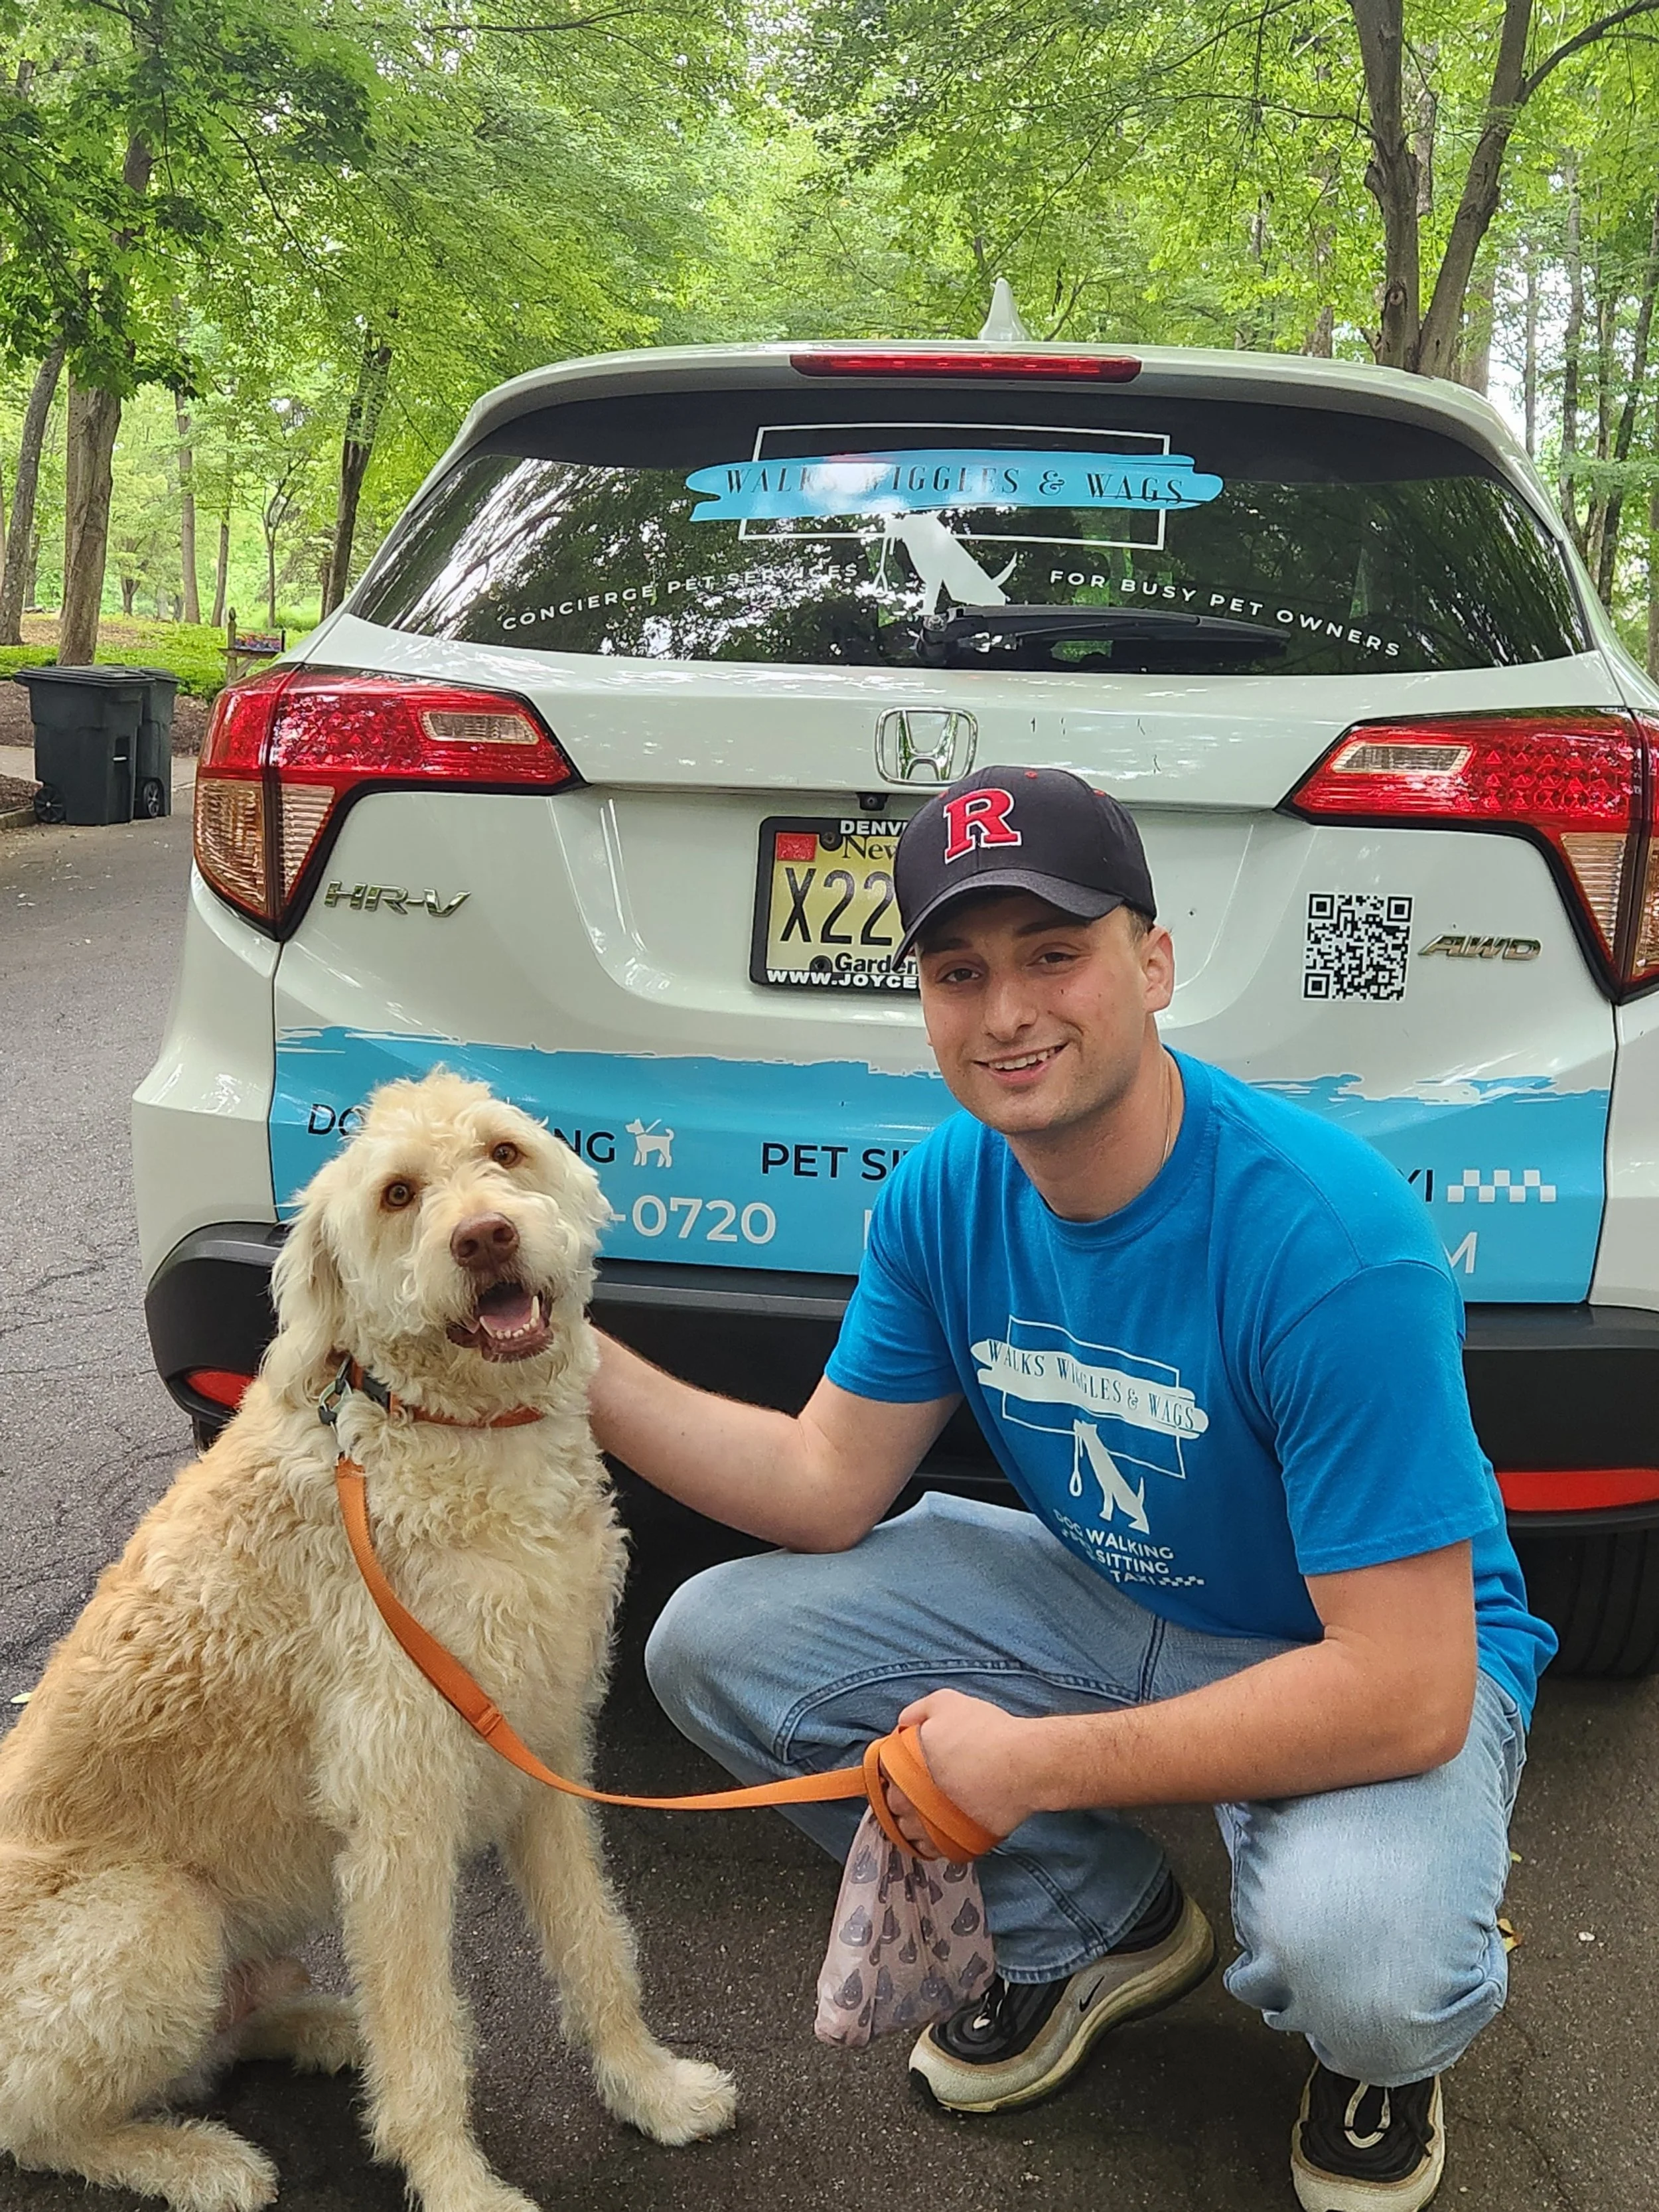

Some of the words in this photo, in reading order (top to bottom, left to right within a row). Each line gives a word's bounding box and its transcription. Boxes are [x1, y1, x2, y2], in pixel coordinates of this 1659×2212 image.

[1039, 470, 1064, 496] &
[1086, 473, 1183, 504] WAGS
[502, 587, 655, 630] CONCIERGE
[668, 575, 715, 594] PET
[727, 563, 857, 585] SERVICES
[1050, 569, 1106, 588] FOR
[1121, 579, 1196, 603] BUSY
[1210, 593, 1263, 616] PET
[1277, 609, 1400, 656] OWNERS
[943, 788, 1022, 863] R
[324, 881, 471, 918] HR-V
[780, 867, 895, 946] X22
[835, 952, 918, 974] Garden
[1418, 934, 1542, 961] AWD
[768, 970, 917, 989] WWW.JOYCE
[308, 1103, 366, 1137] DO
[761, 1142, 849, 1178] PET
[861, 1148, 908, 1181] SI
[610, 1195, 776, 1244] -0720
[987, 1339, 1046, 1376] WALKS
[1127, 1387, 1139, 1410] &
[1149, 1392, 1194, 1430] WAGS
[1085, 1528, 1174, 1560] WALKING
[1095, 1549, 1170, 1575] SITTING
[1110, 1570, 1156, 1585] TAXI
